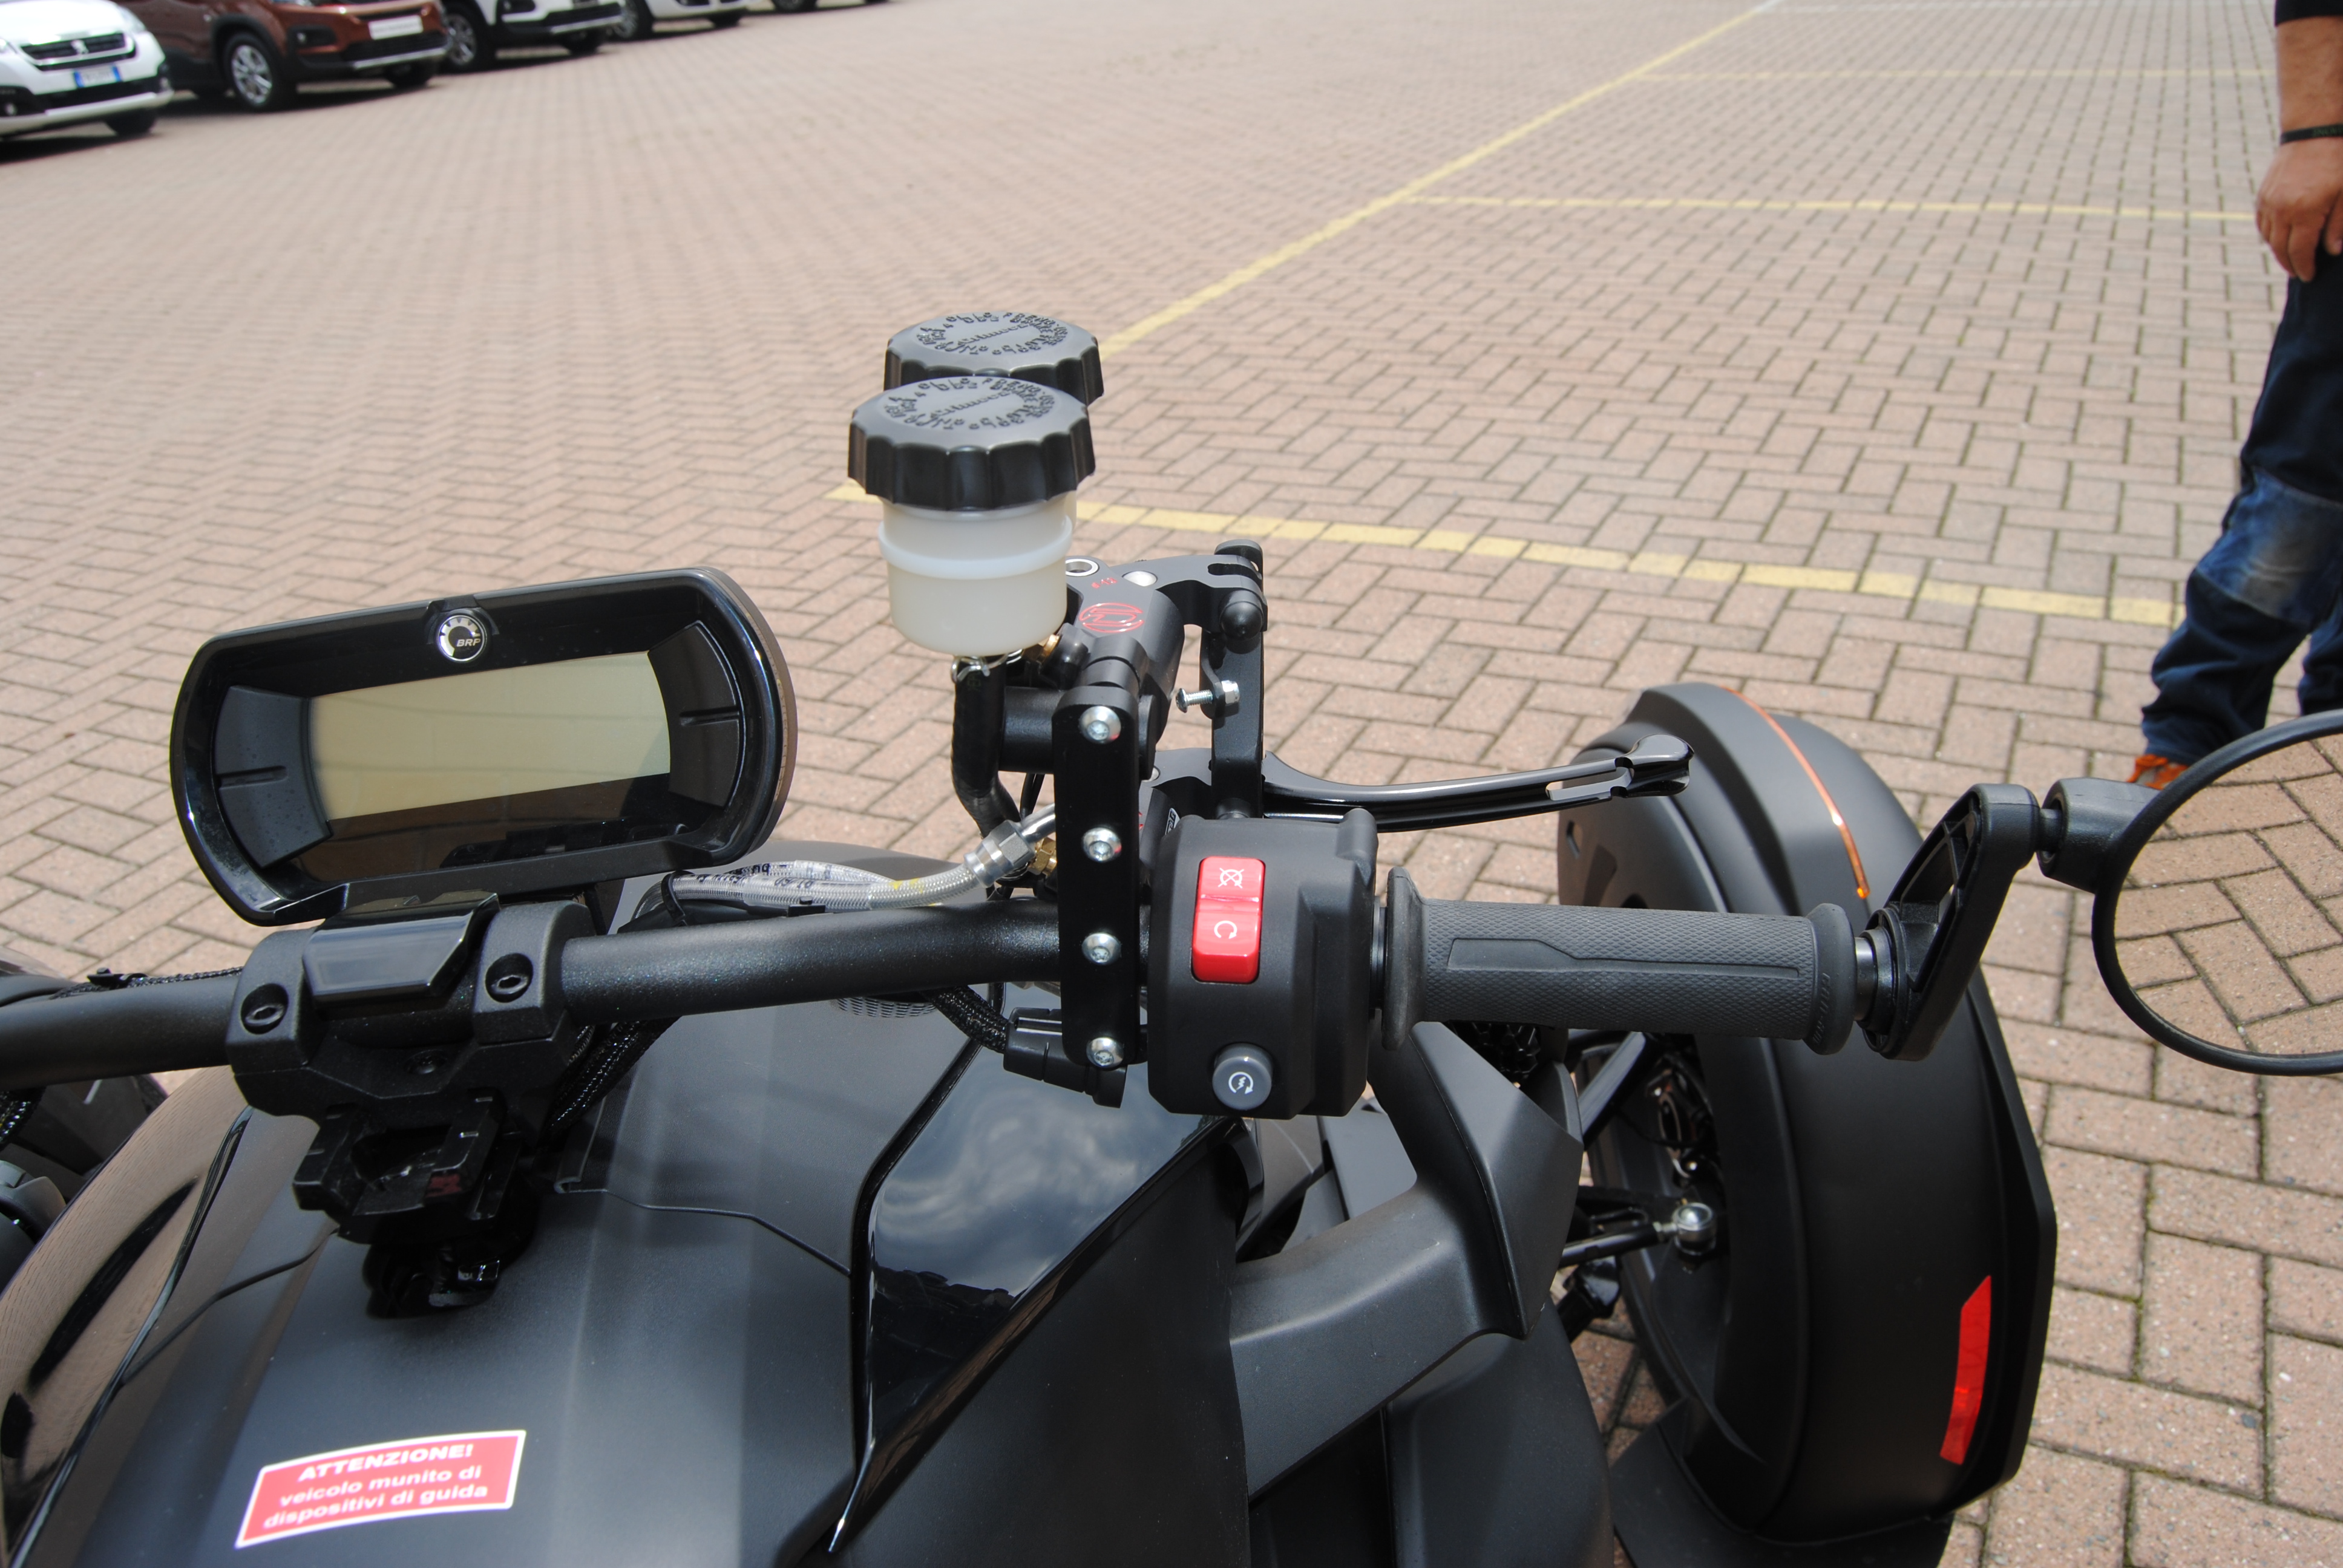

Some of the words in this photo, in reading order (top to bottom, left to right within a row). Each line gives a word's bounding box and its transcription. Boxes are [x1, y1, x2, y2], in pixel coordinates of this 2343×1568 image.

[456, 638, 481, 647] BRP
[297, 1443, 474, 1482] ATTENZIONE!
[263, 1492, 385, 1529] dispositivi
[390, 1489, 415, 1506] di
[419, 1483, 488, 1506] guida
[280, 1480, 363, 1508] veicolo
[368, 1469, 453, 1491] munito
[458, 1465, 482, 1480] di
